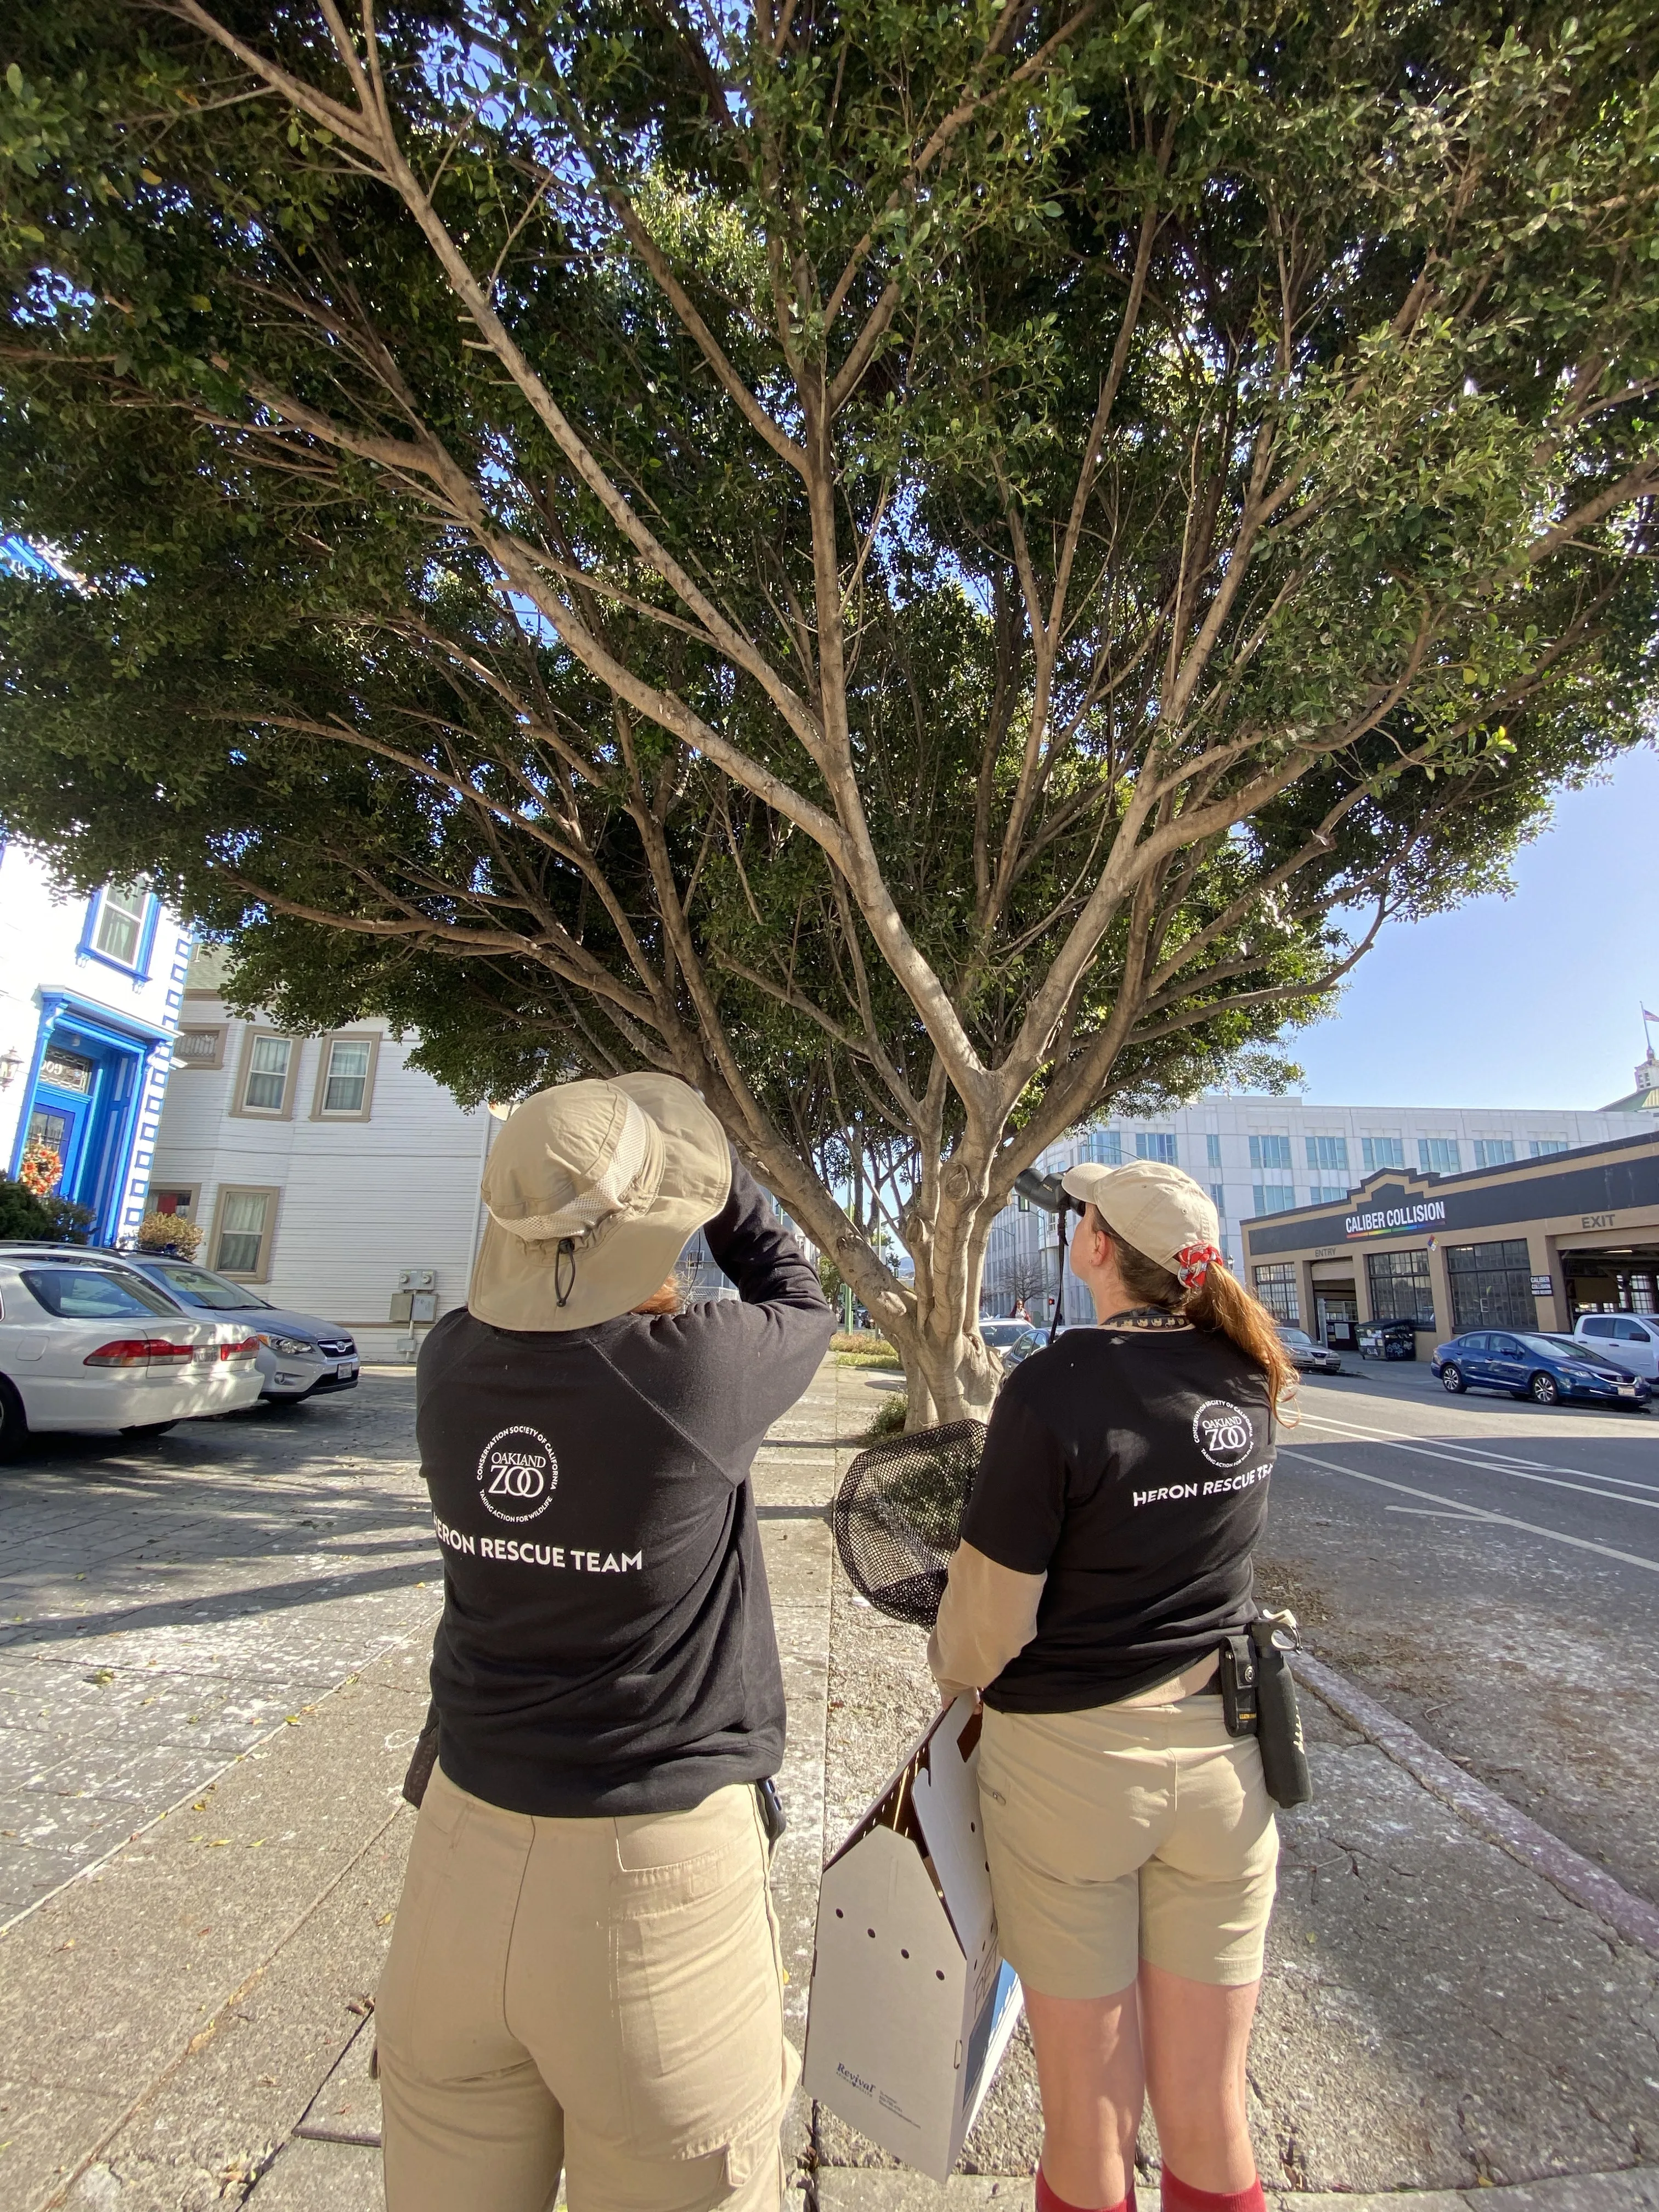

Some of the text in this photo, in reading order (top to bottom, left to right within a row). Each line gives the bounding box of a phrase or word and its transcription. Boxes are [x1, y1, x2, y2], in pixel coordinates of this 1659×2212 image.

[1345, 1201, 1446, 1233] CALIBER COLLISION
[1581, 1214, 1616, 1228] EXIT
[1315, 1247, 1336, 1257] ENTRY
[1202, 1416, 1242, 1430] OAKLAND
[1204, 1425, 1246, 1451] ZOO
[476, 1426, 559, 1490] CONSERVATION SOCIETY OF CALIFORNIA
[491, 1452, 546, 1468] OAKLAND
[1200, 1448, 1216, 1465] TAKING
[488, 1464, 544, 1498] ZOO
[1132, 1482, 1198, 1507] HERON
[1203, 1469, 1256, 1496] RESCUE
[479, 1488, 494, 1513] TAKING
[492, 1510, 515, 1522] ACTION
[528, 1496, 554, 1520] WILDLIFE
[480, 1538, 566, 1568] RESCUE
[570, 1550, 642, 1573] TEAM
[837, 2062, 877, 2093] Revival
